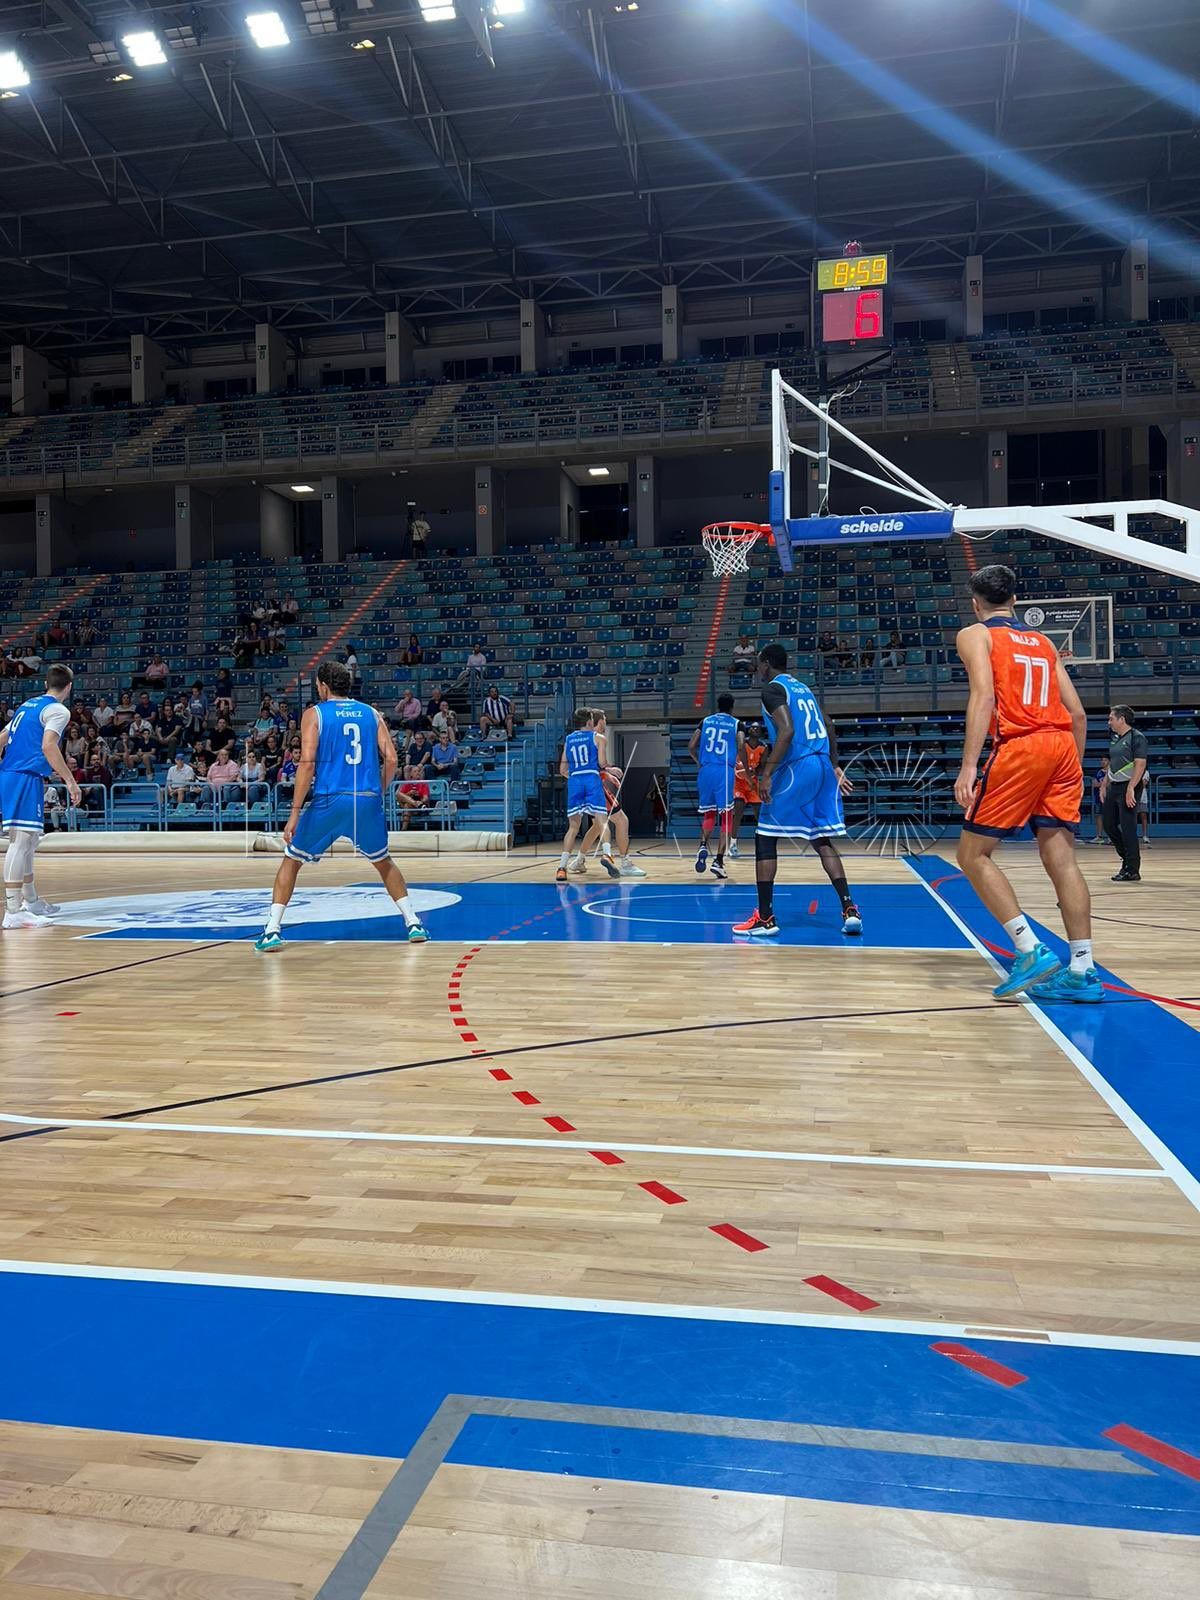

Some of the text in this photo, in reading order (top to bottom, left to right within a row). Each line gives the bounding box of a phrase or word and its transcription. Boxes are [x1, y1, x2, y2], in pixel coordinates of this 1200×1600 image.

[834, 259, 886, 286] 8:59
[856, 292, 879, 338] 6
[840, 519, 904, 534] schelde
[1013, 653, 1049, 707] 77
[335, 708, 363, 718] PÉREZ
[797, 698, 827, 741] 23
[343, 722, 363, 765] 3
[705, 726, 729, 755] 35
[570, 743, 589, 769] 10
